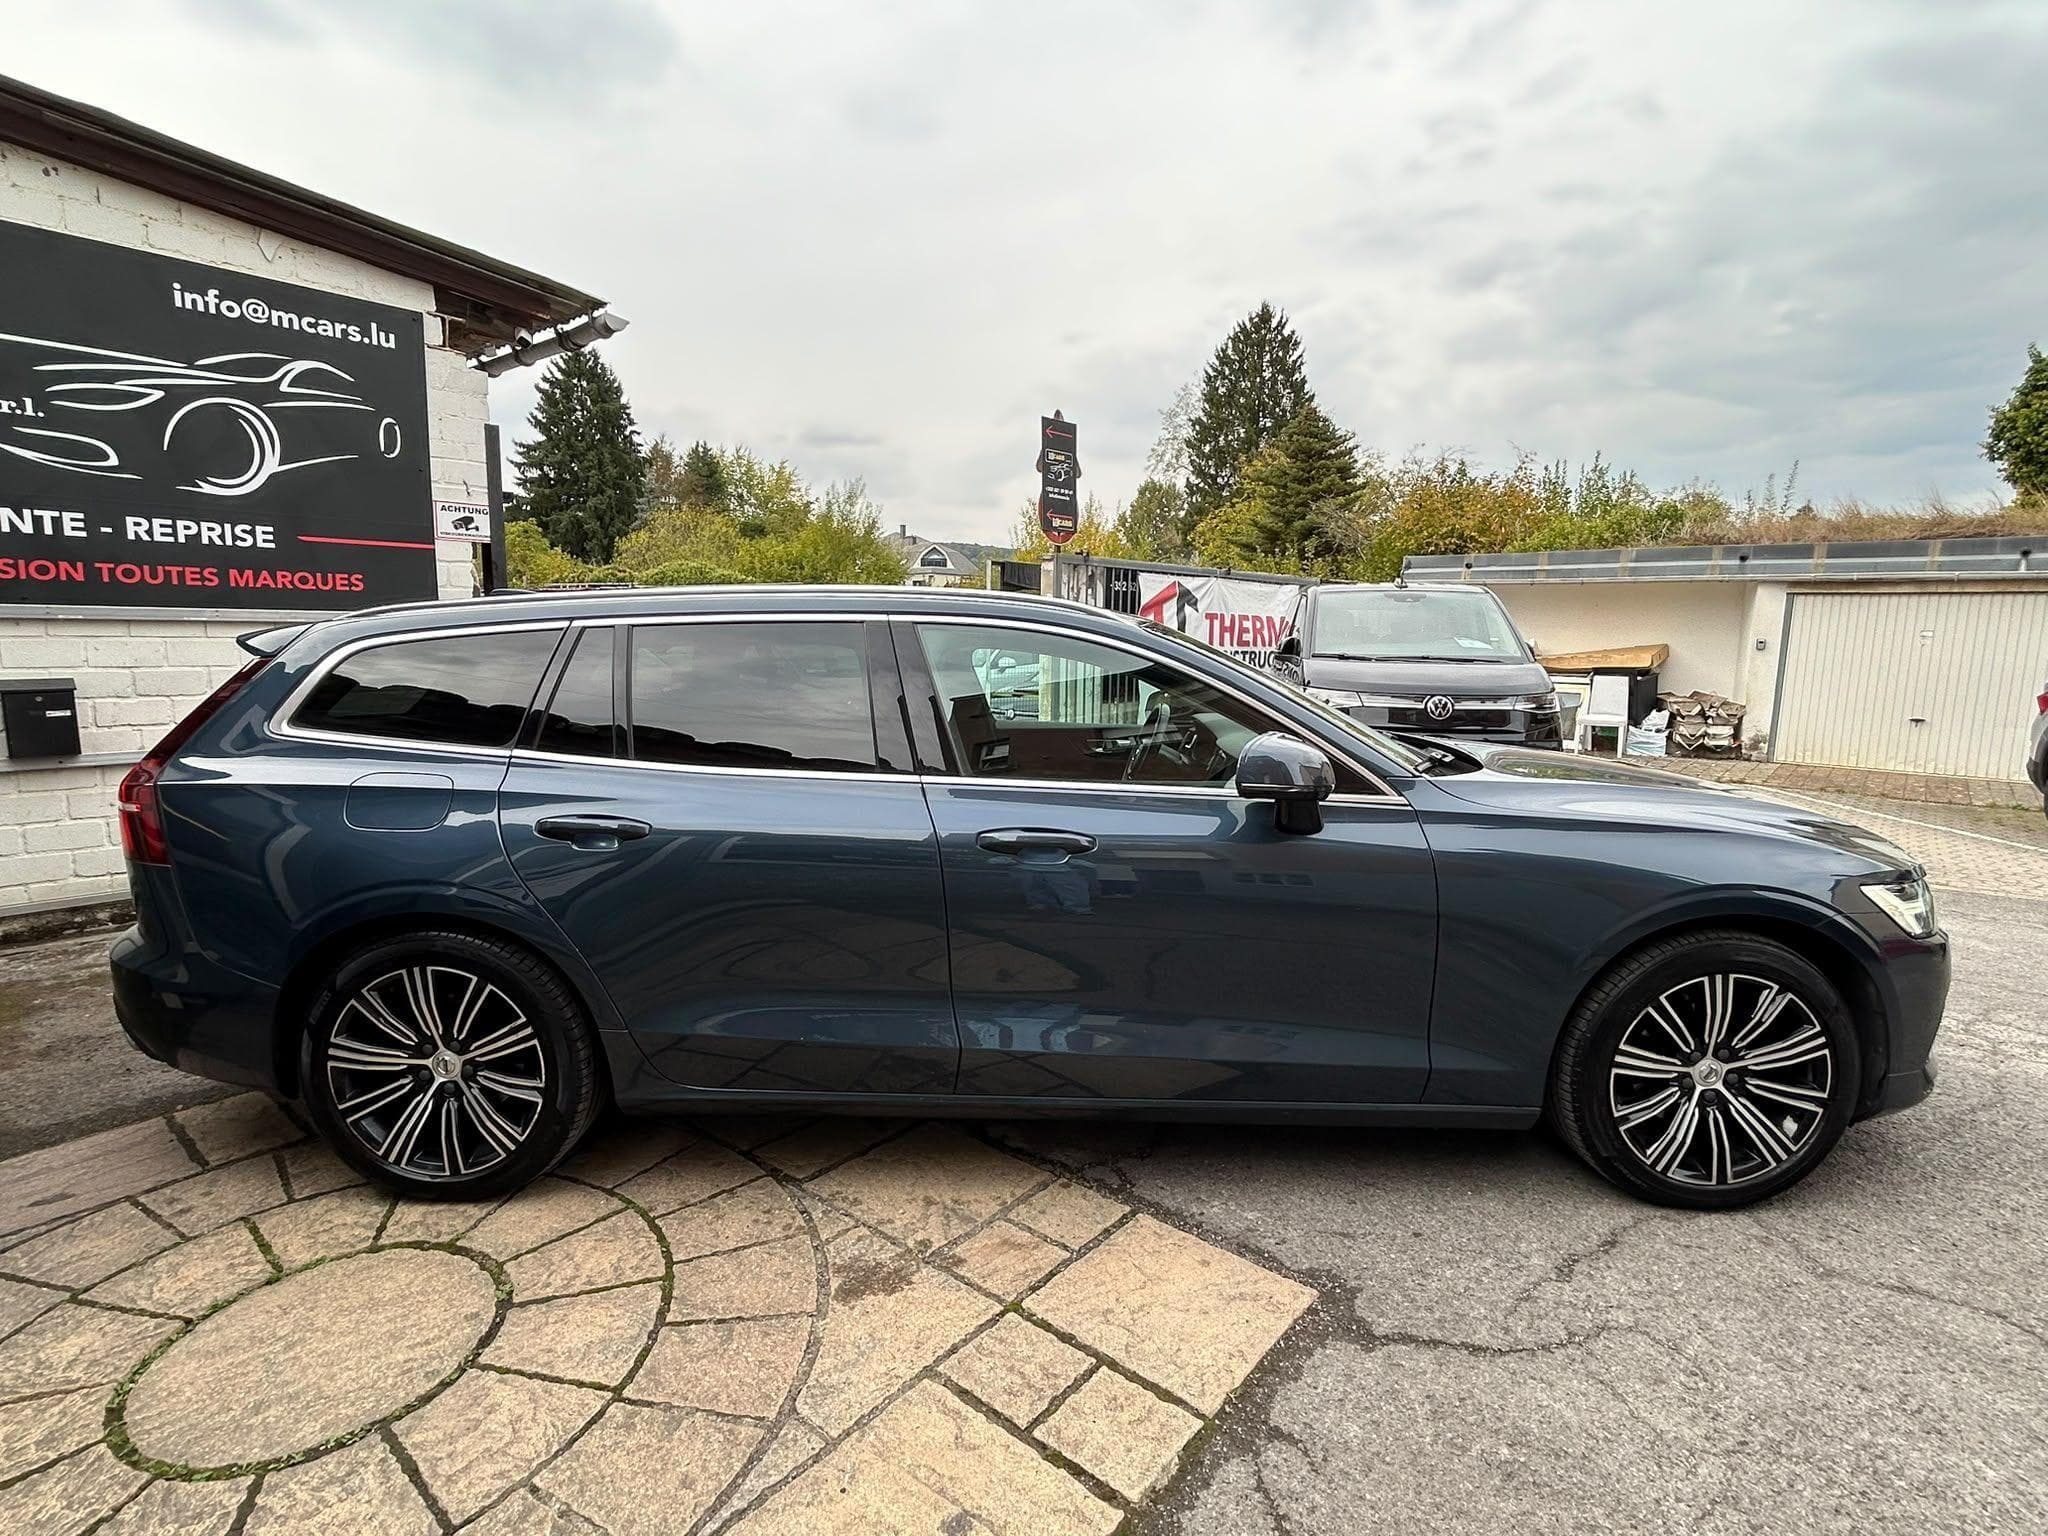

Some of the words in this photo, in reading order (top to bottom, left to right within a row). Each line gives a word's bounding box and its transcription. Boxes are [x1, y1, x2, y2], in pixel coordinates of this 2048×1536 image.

[172, 282, 396, 349] info@mcars.lu
[0, 507, 88, 537] NTE
[125, 516, 276, 548] REPRISE
[440, 505, 489, 515] ACHTUNG
[94, 562, 219, 587] TOUTES
[229, 568, 365, 592] MARQUES
